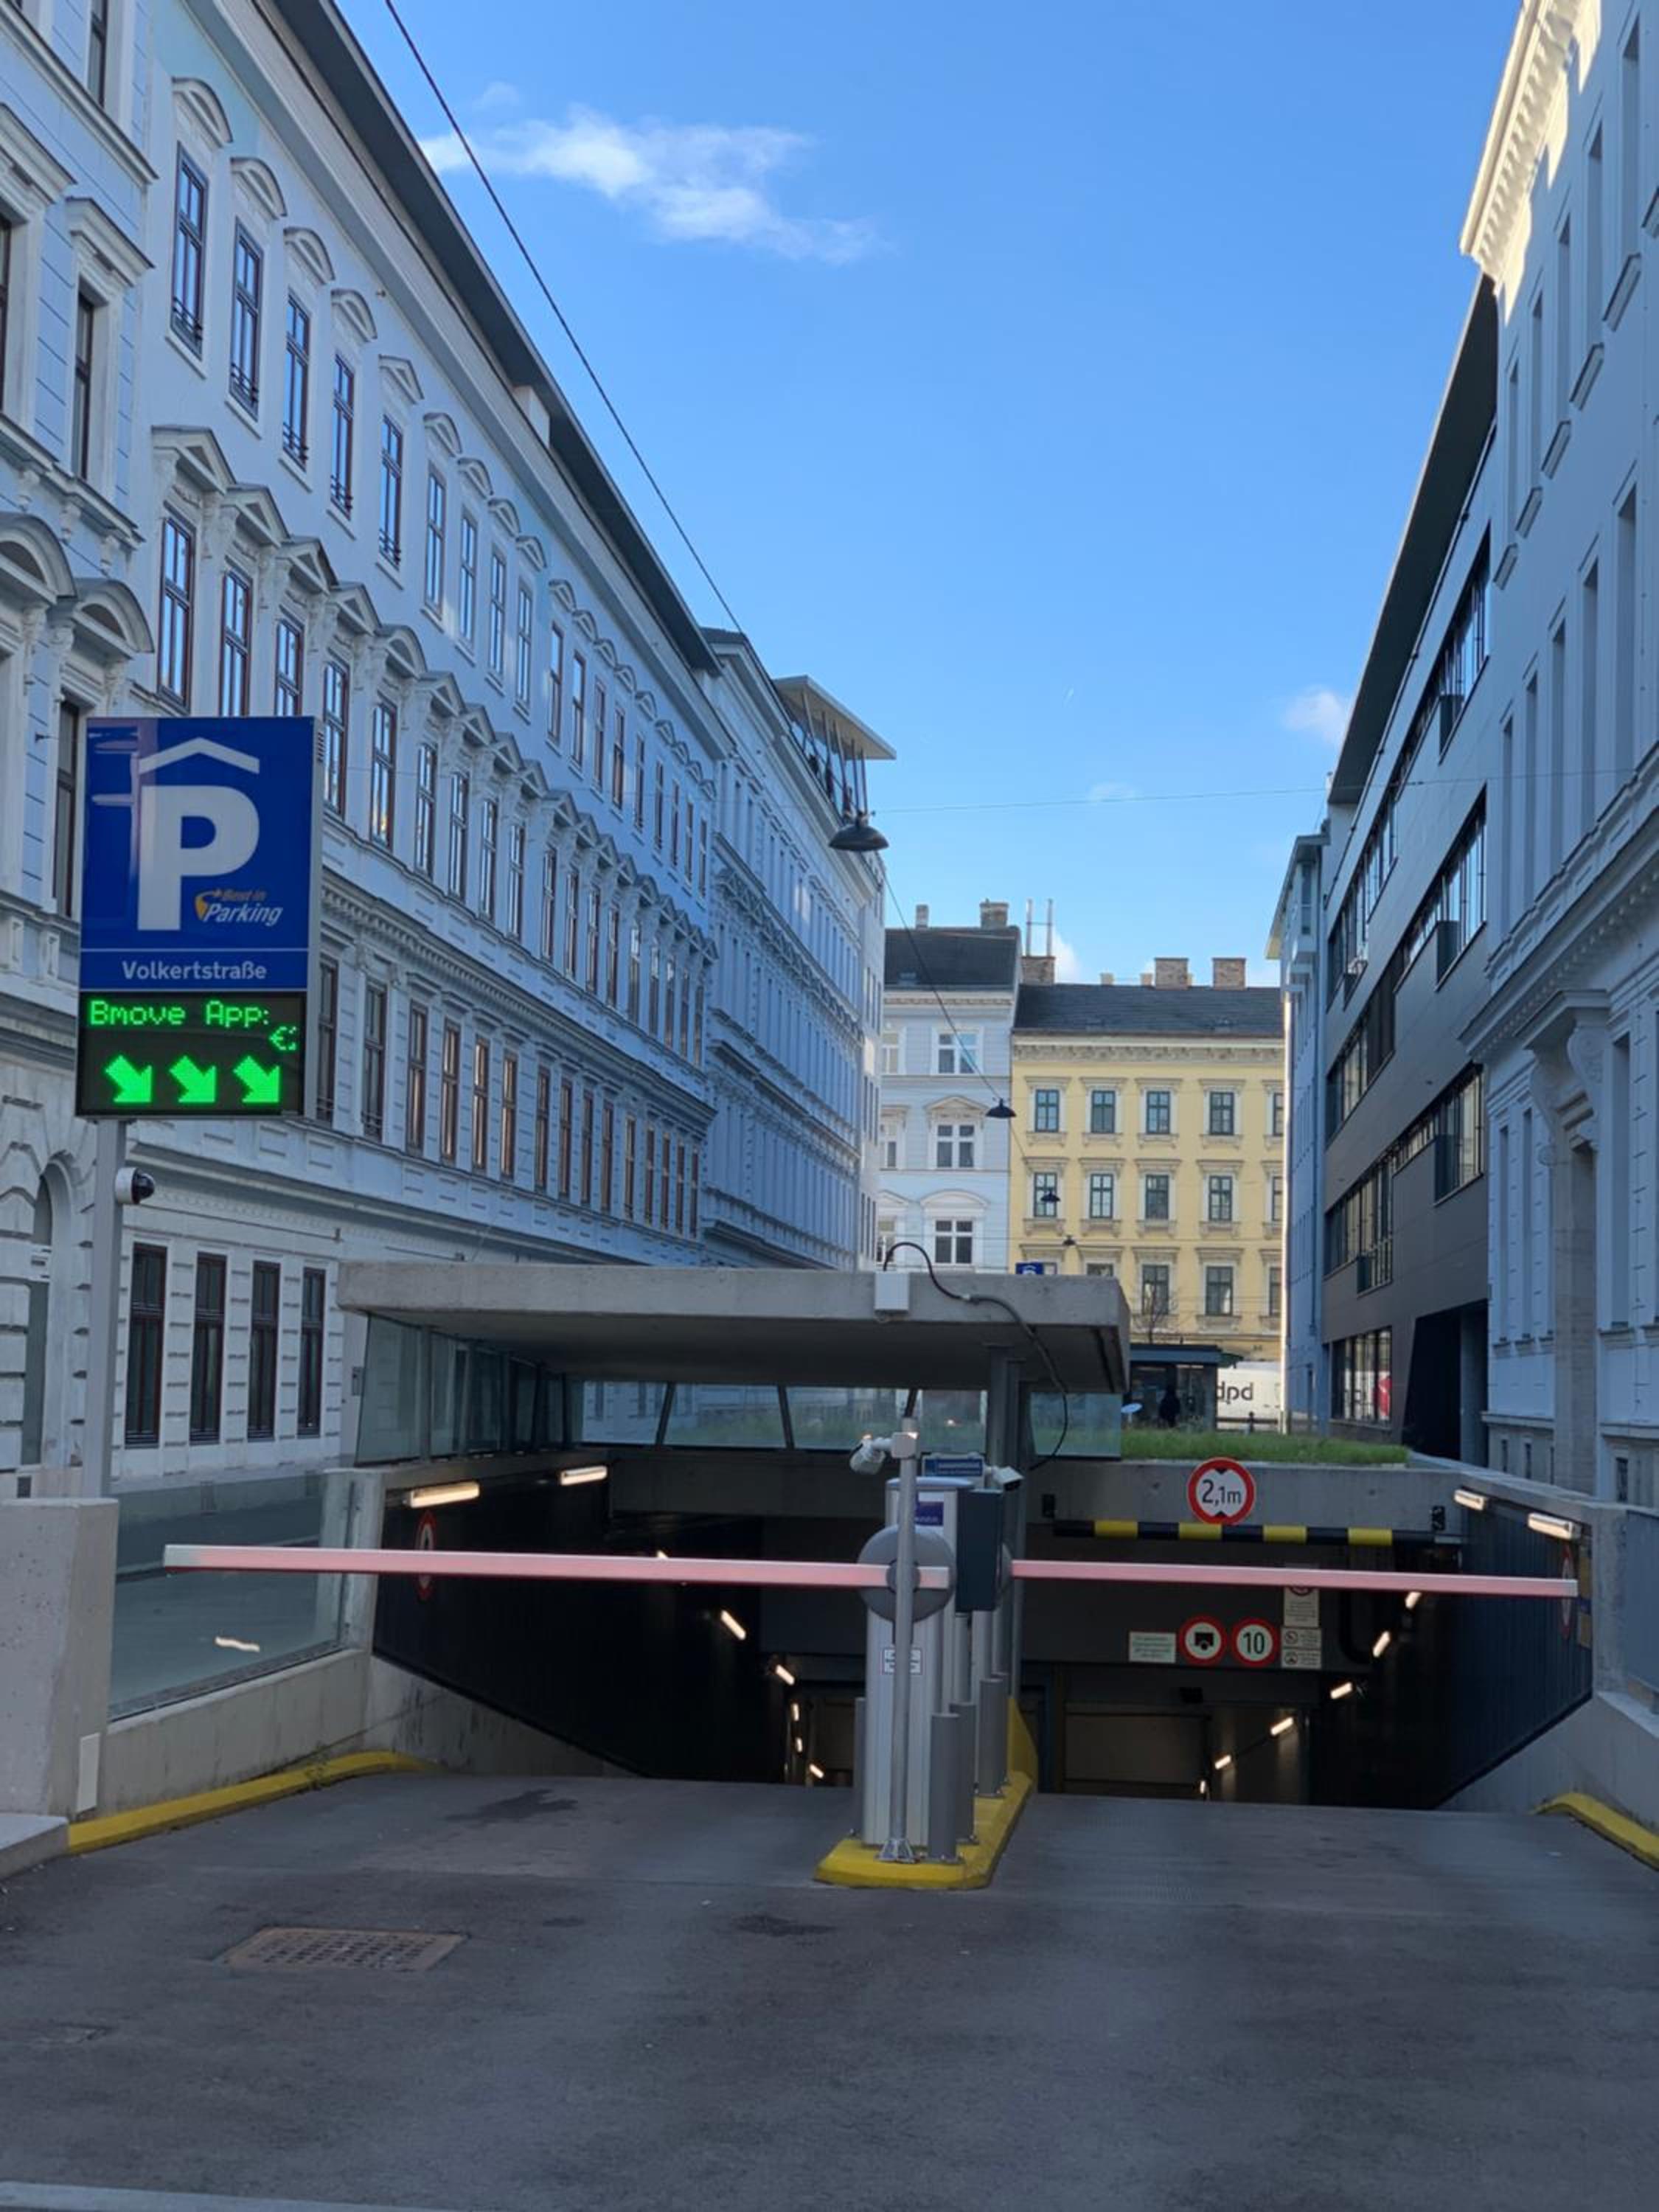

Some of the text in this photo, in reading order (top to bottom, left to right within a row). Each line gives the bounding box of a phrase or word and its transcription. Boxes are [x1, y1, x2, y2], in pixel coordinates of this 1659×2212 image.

[138, 785, 260, 931] P
[202, 902, 283, 927] Parking
[122, 960, 267, 980] Volkertstraße
[89, 999, 269, 1028] Bmove App:
[1217, 1380, 1253, 1405] dpd
[1202, 1478, 1242, 1506] 2,1m
[1243, 1632, 1265, 1655] 10
